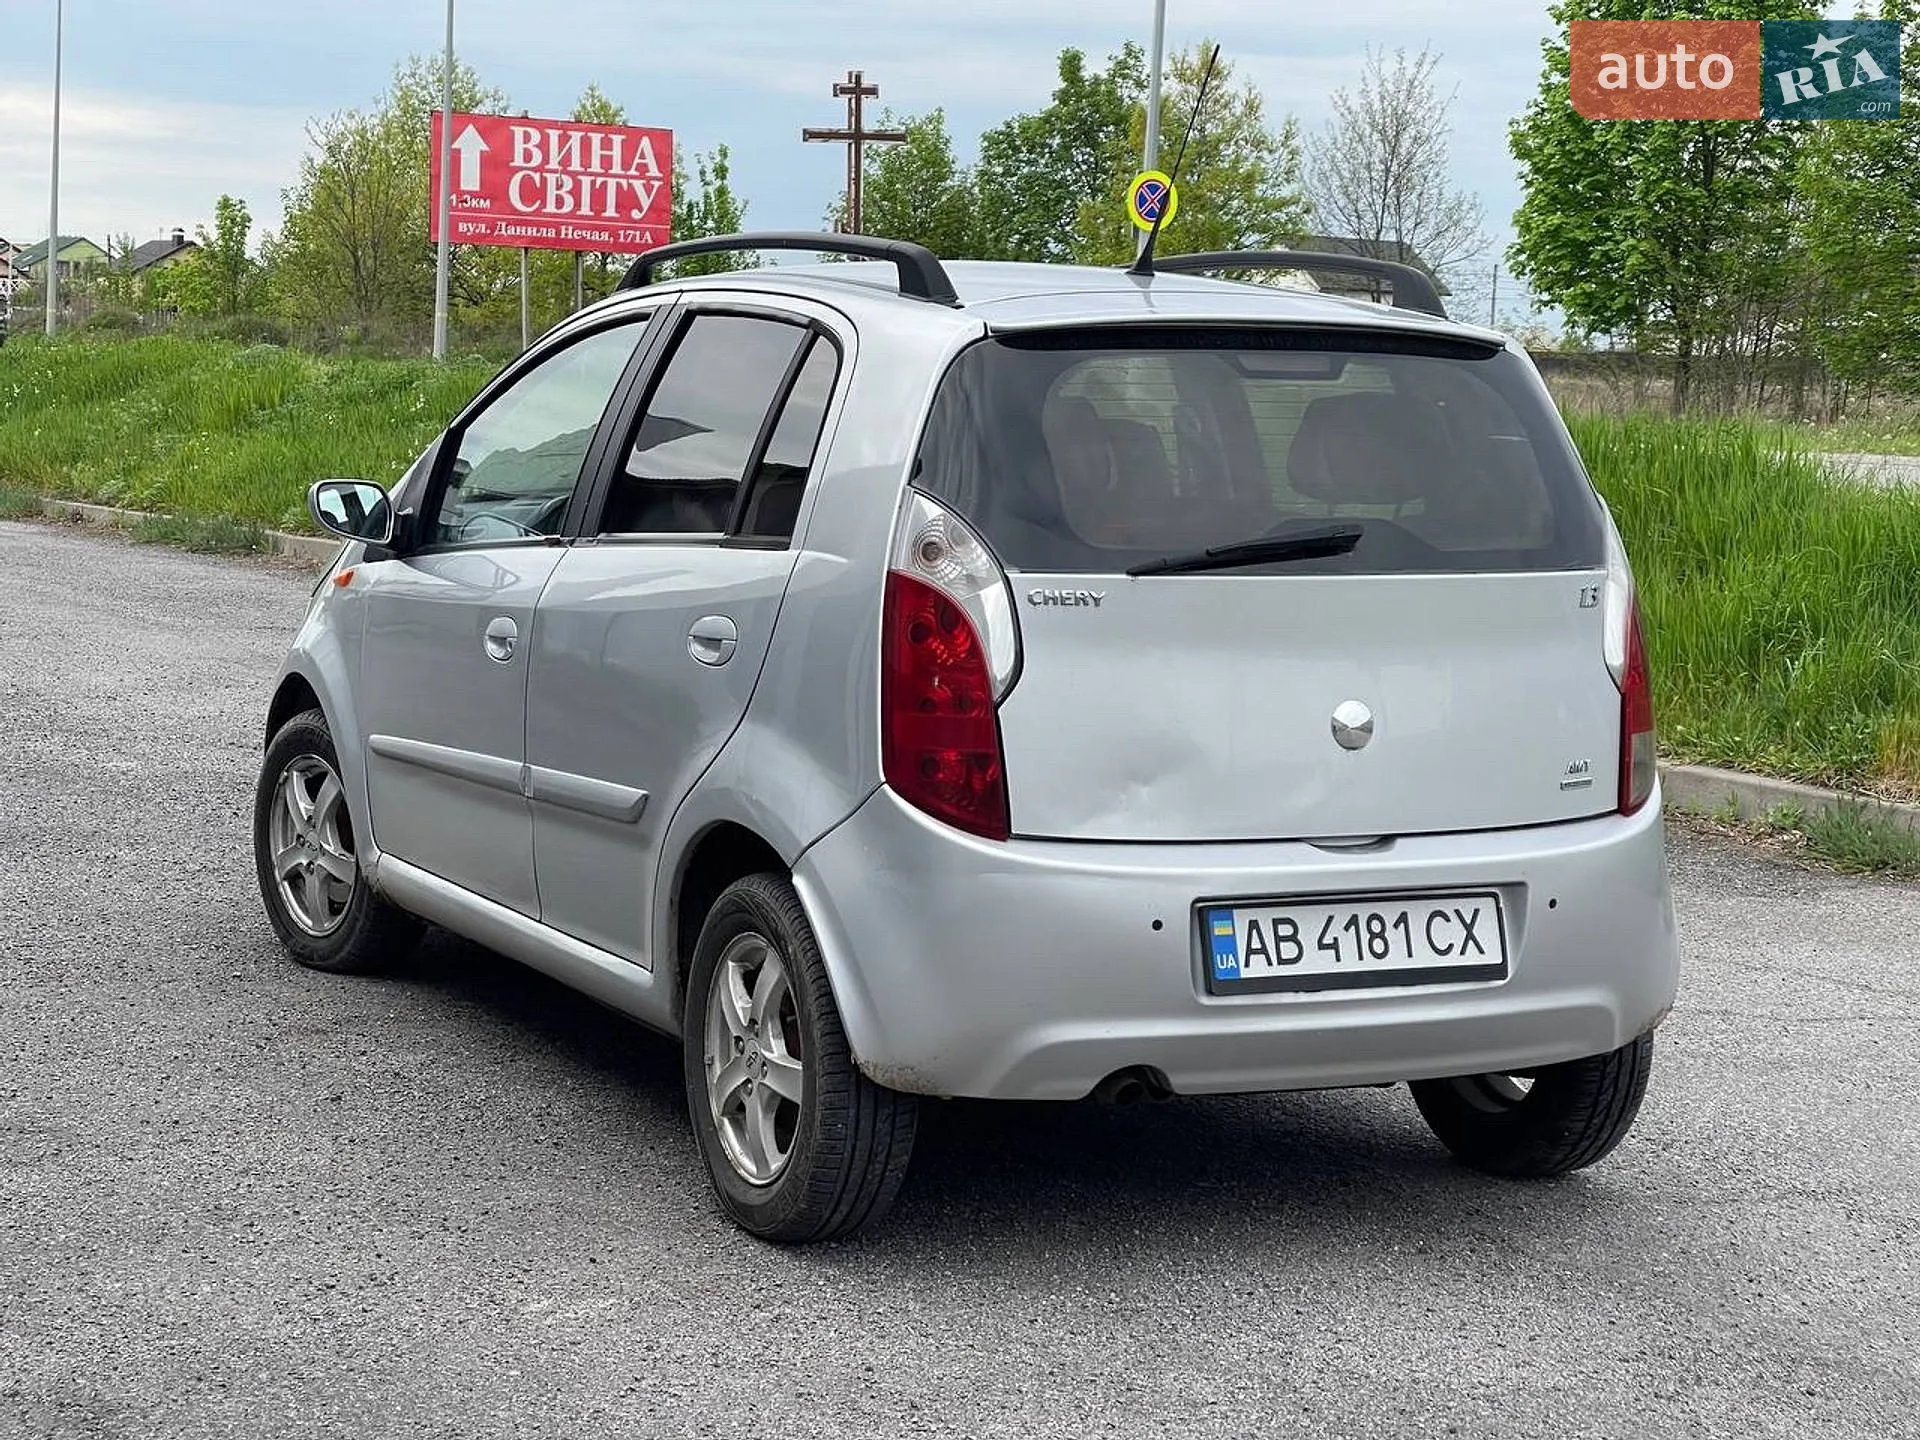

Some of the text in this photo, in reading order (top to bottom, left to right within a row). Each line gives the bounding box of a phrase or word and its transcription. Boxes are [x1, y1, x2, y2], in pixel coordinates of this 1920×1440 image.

[509, 125, 663, 178] ВИНА
[508, 170, 663, 221] СВІТУ
[458, 221, 653, 244] вул. Данила Нечая, 171А
[1027, 588, 1106, 607] CHERY
[1243, 907, 1486, 969] AB 4181 CX
[1216, 953, 1238, 970] UA
